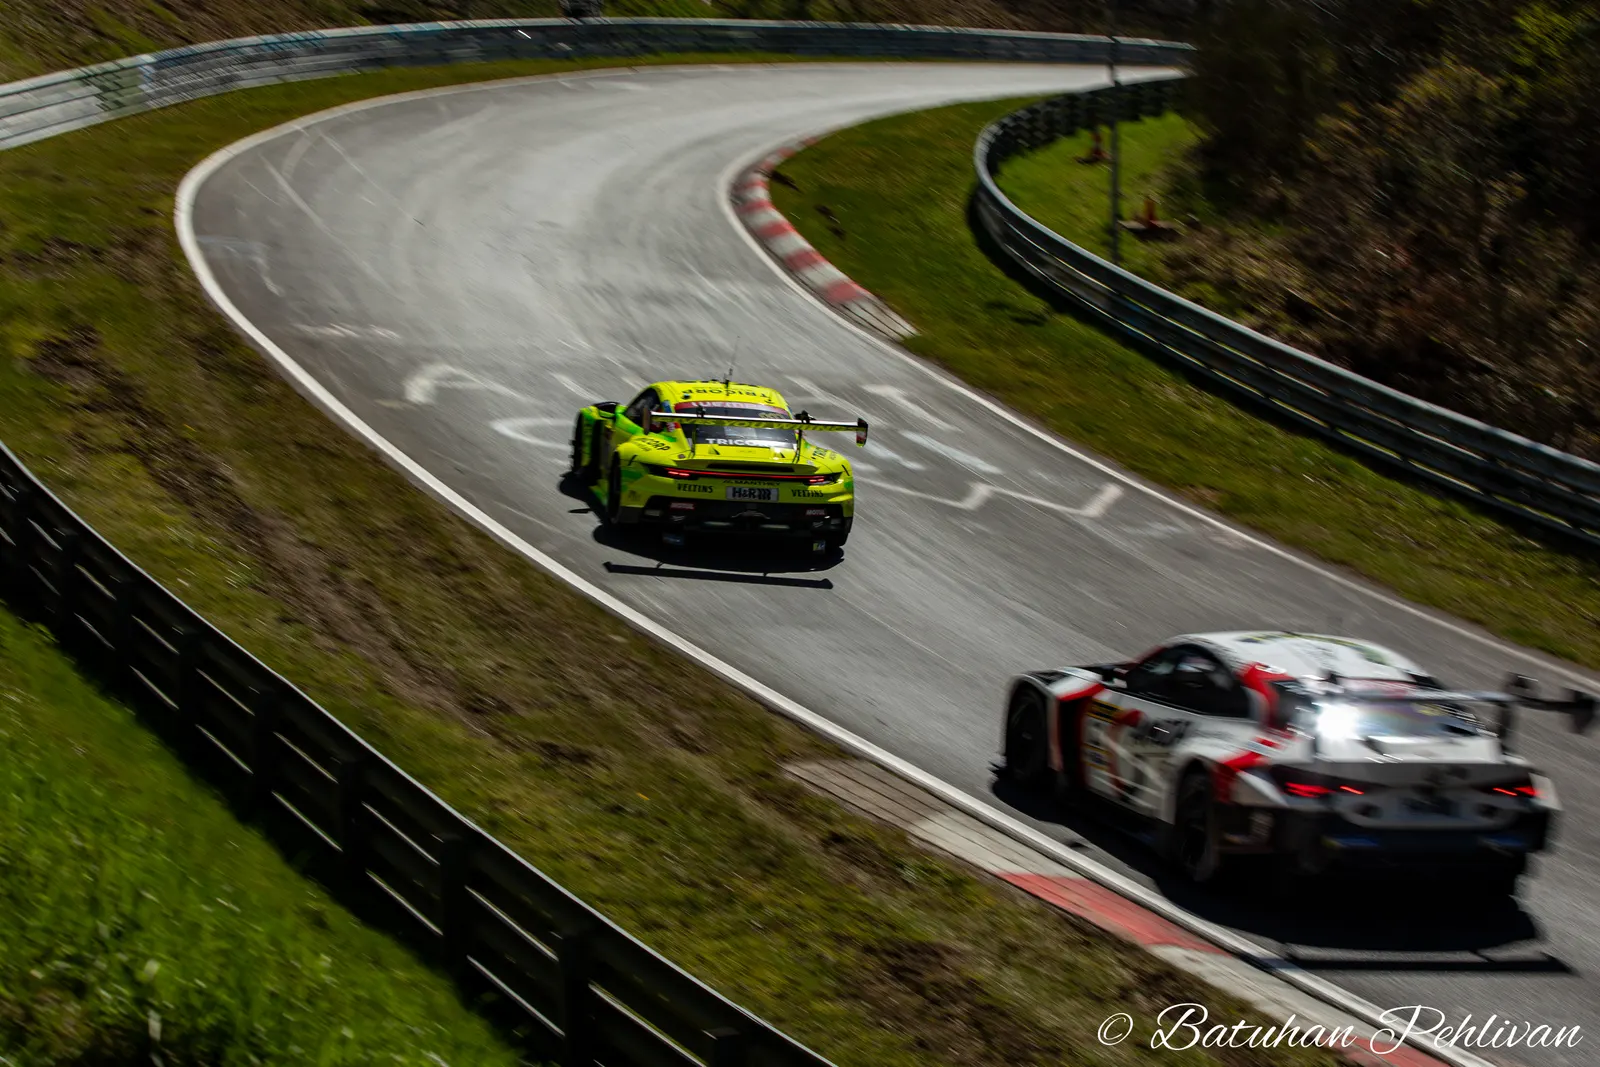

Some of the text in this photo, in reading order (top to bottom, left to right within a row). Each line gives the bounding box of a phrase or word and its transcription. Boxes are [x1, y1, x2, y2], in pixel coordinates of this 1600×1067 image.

[705, 438, 779, 448] TRICO
[677, 483, 713, 493] VELTINS
[791, 489, 824, 498] VELTINS
